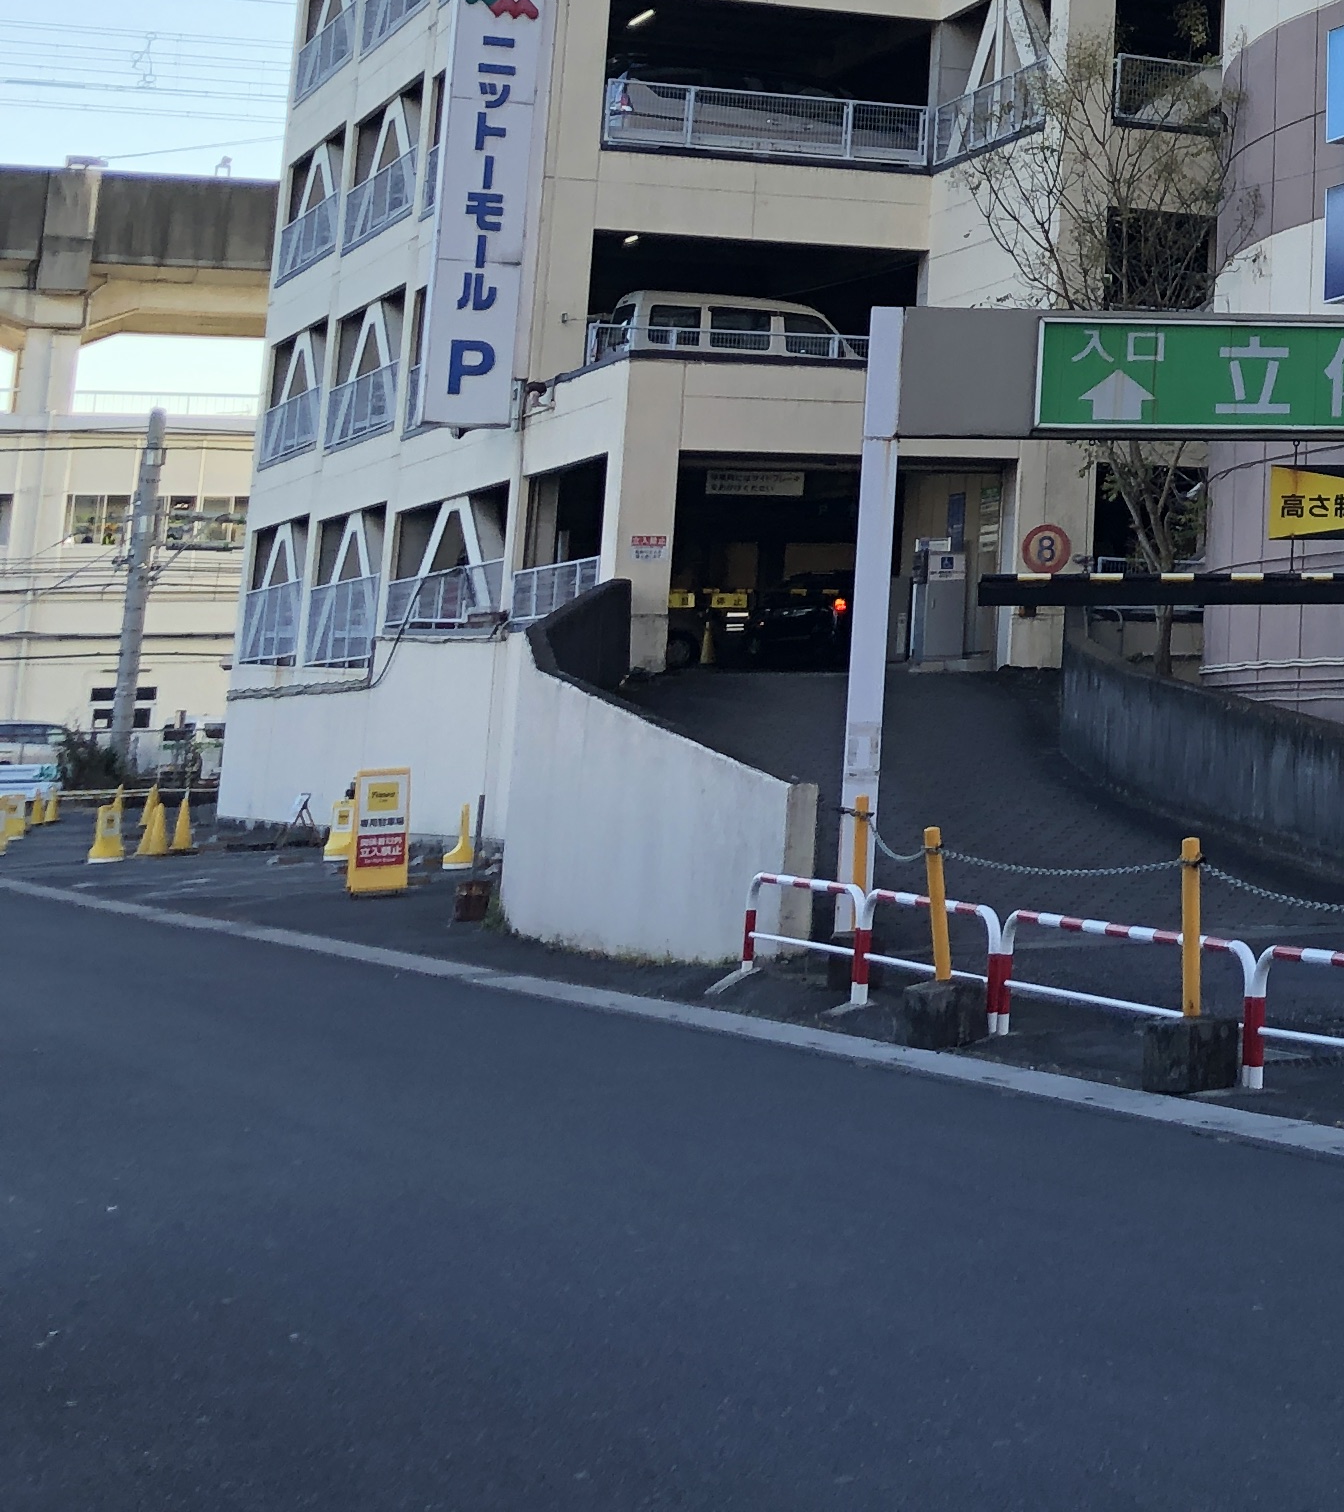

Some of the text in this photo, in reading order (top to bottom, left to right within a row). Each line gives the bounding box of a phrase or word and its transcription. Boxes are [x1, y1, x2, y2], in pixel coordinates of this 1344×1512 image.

[447, 35, 516, 396] ニットーモール P
[1071, 329, 1166, 364] 入口
[1037, 535, 1056, 562] 8
[359, 846, 403, 858] 立入禁止
